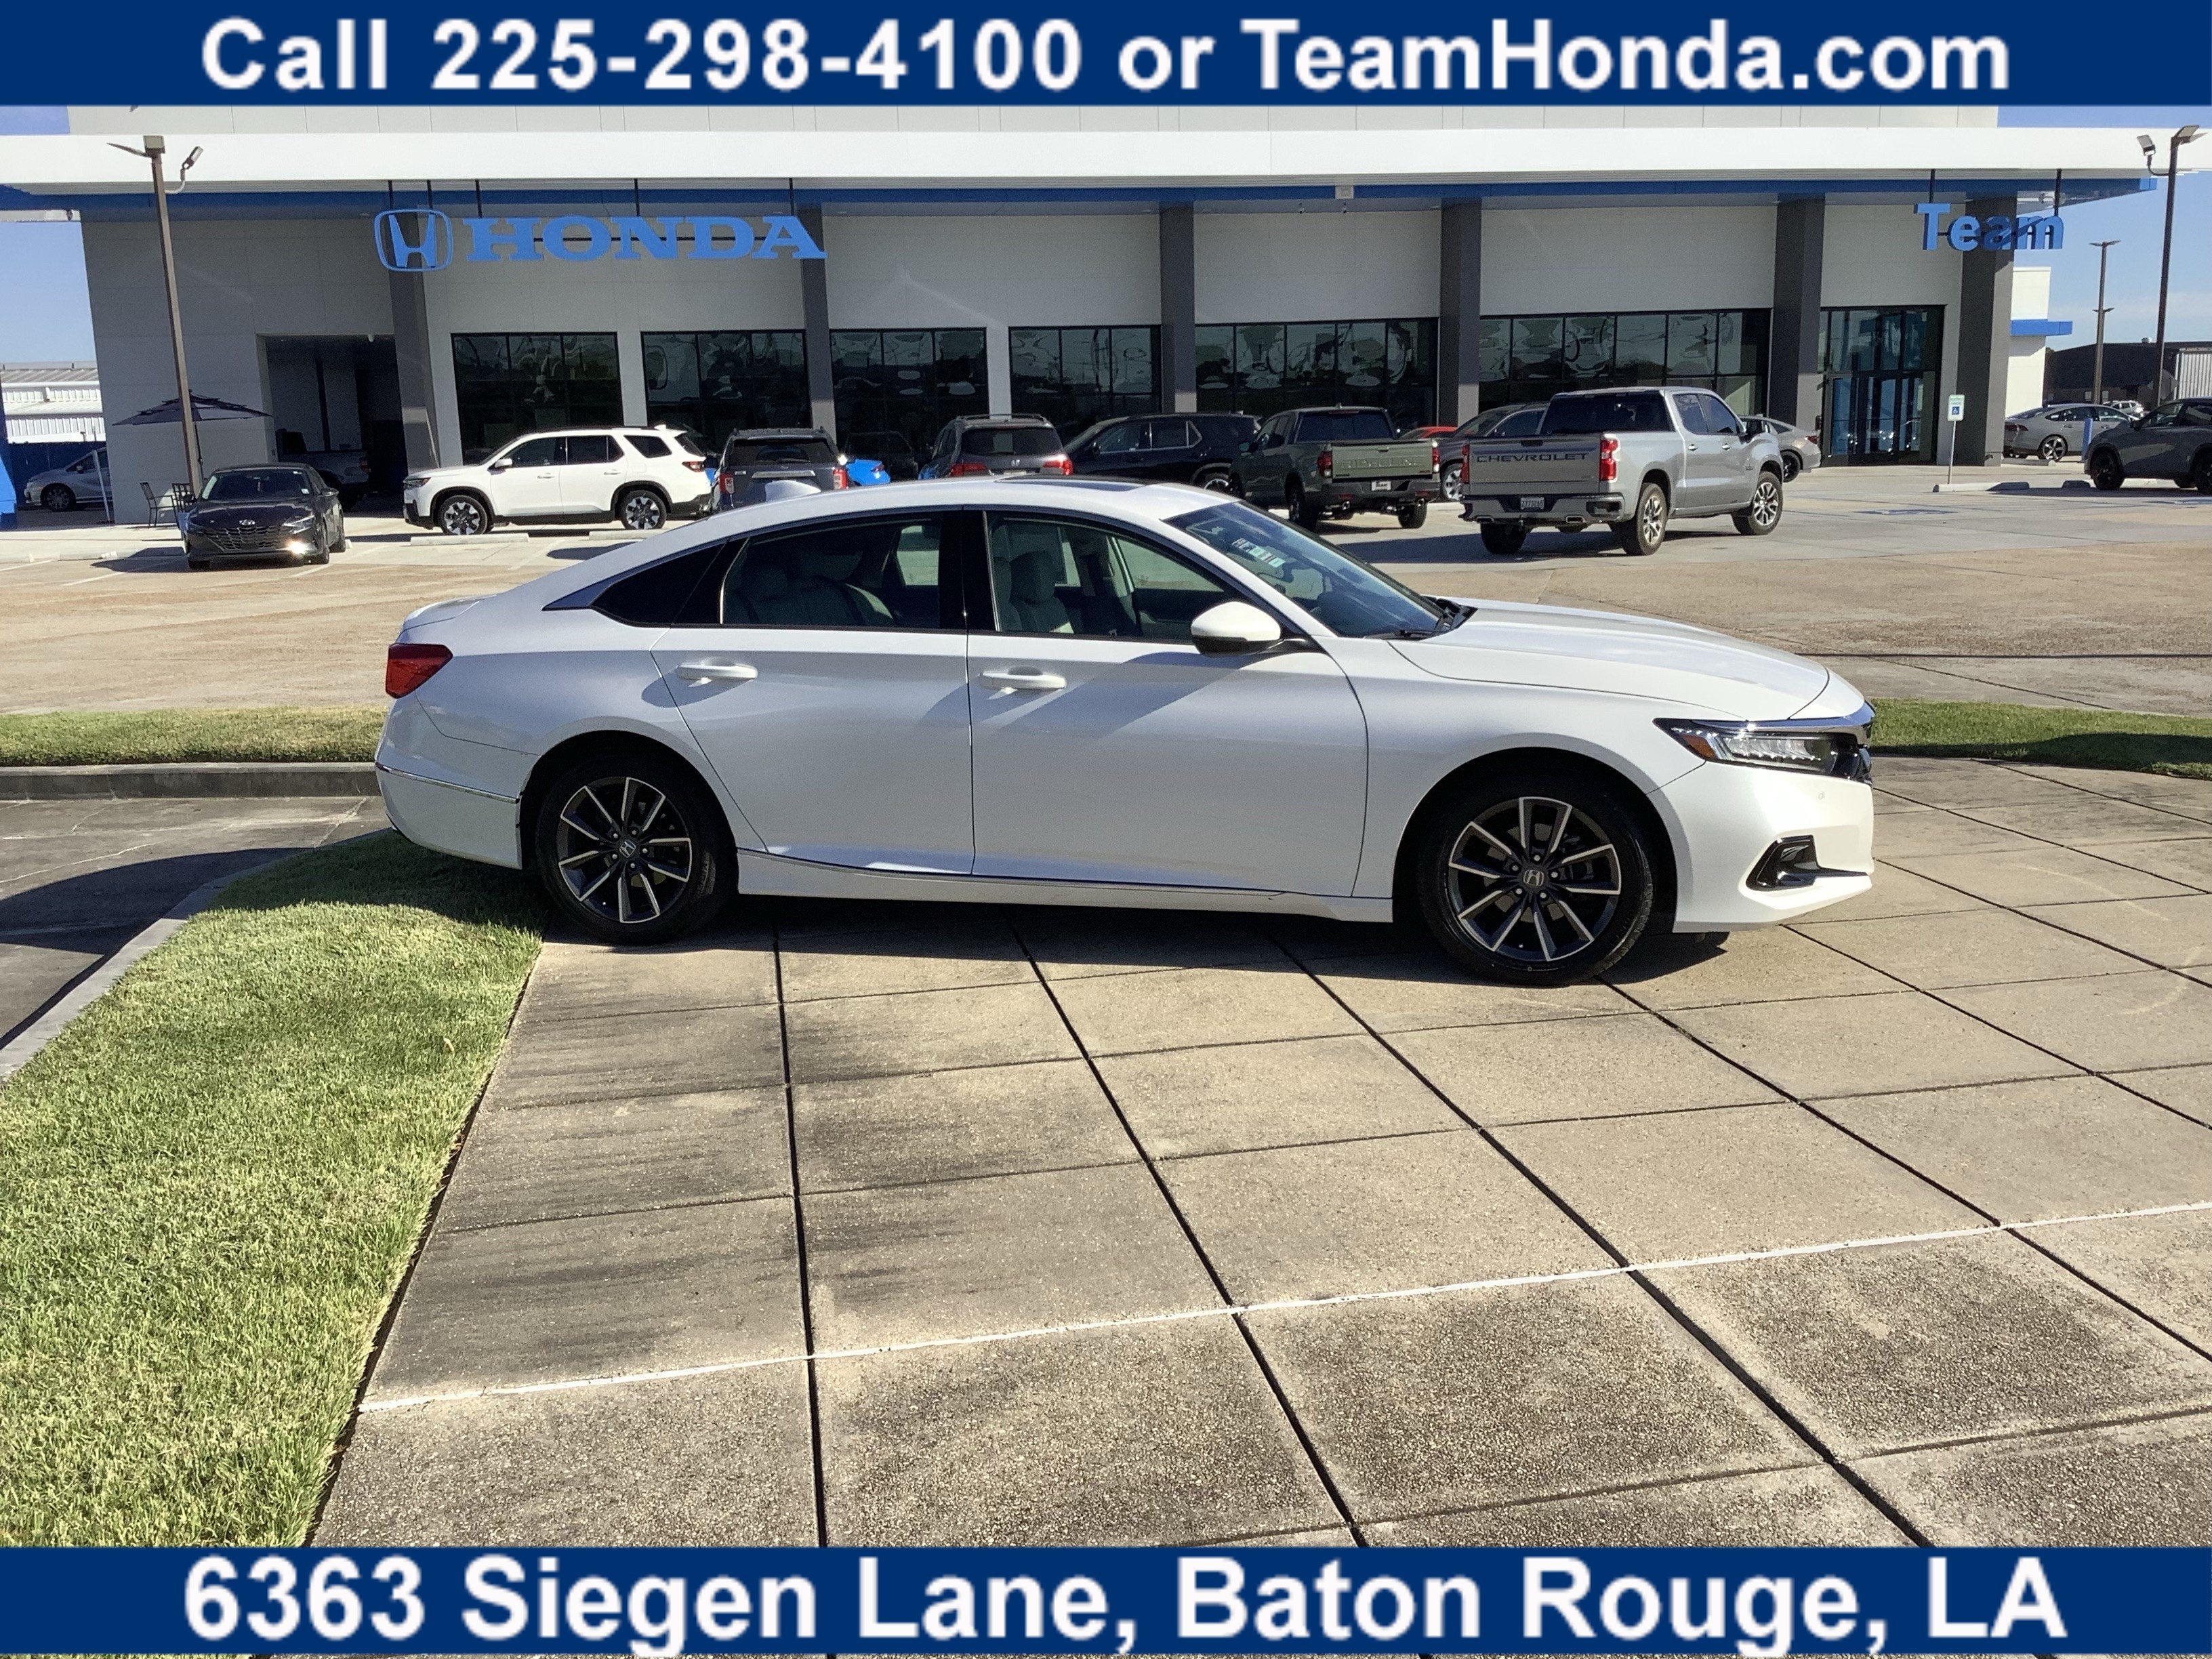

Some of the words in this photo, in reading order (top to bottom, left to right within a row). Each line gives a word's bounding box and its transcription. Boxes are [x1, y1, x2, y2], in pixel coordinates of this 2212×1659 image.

[464, 215, 827, 262] HONDA
[1914, 203, 2064, 251] Team
[1476, 453, 1590, 463] CHEVROLET
